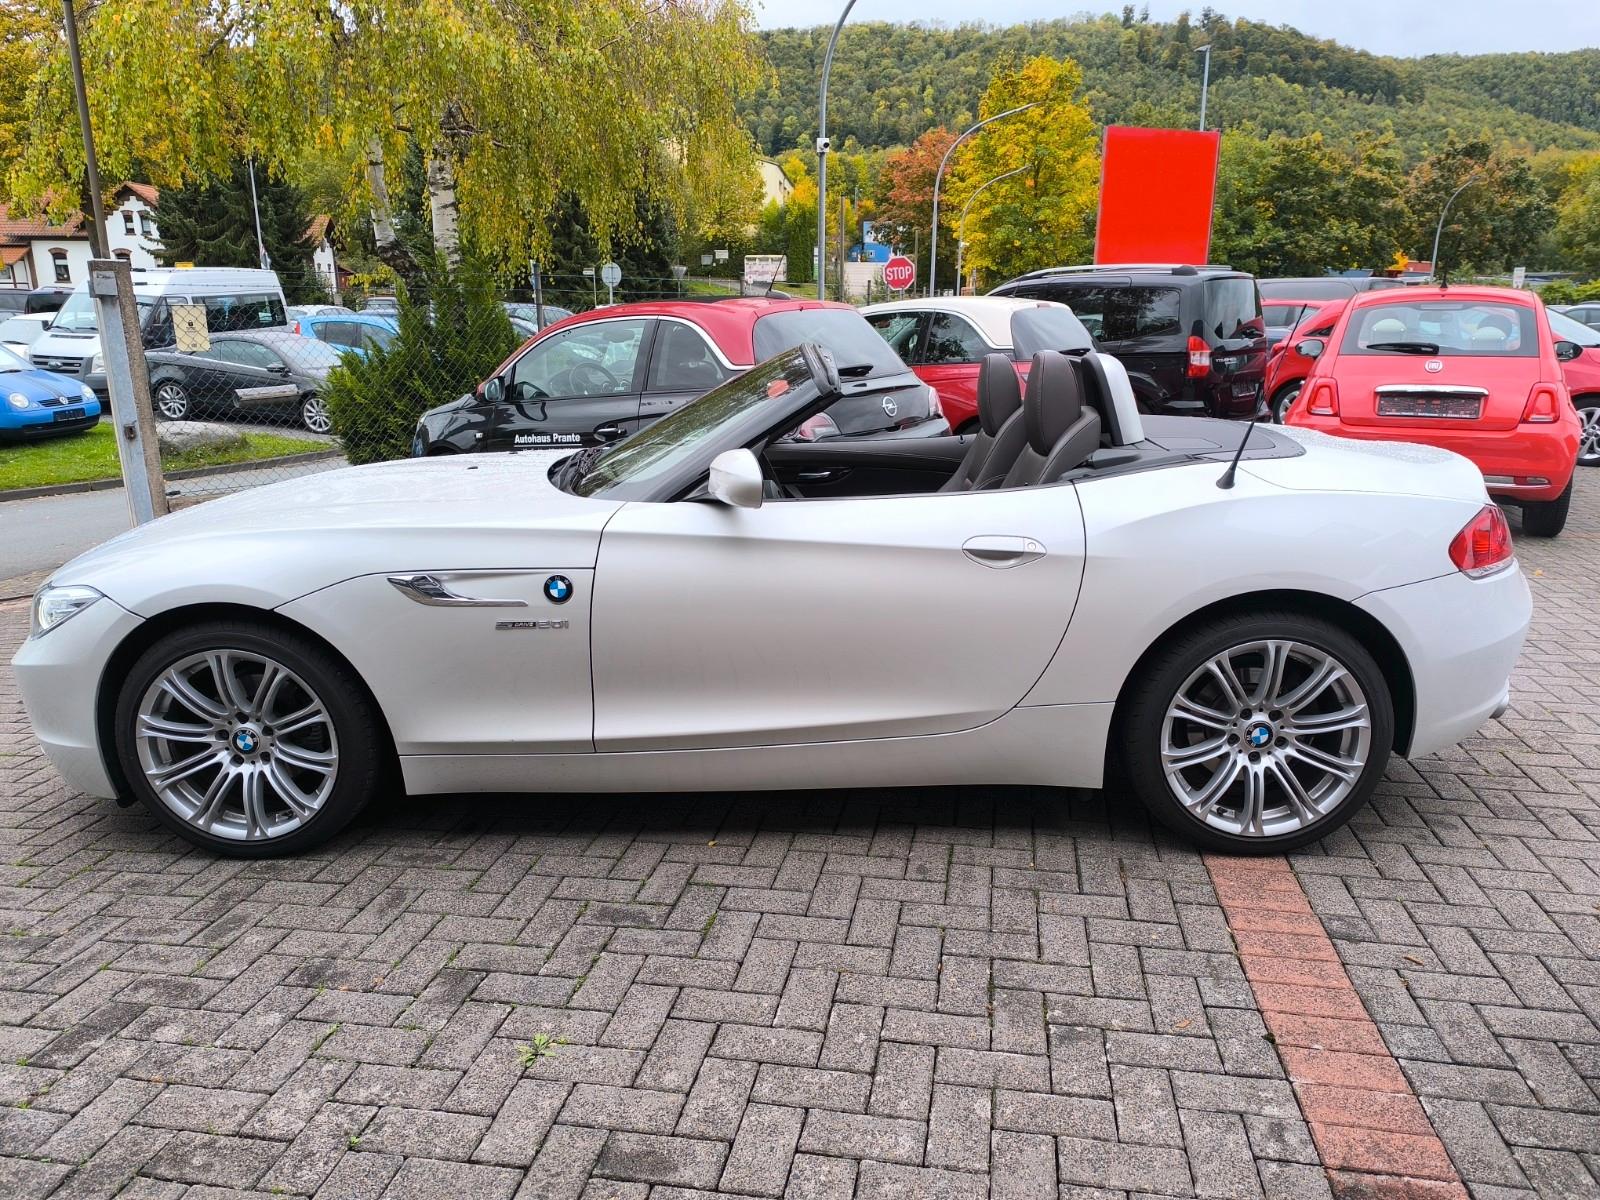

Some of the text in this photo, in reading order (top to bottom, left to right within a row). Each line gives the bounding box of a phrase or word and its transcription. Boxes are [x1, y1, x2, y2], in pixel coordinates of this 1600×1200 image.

[886, 266, 912, 281] STOP
[514, 432, 581, 444] Autohaus Prante
